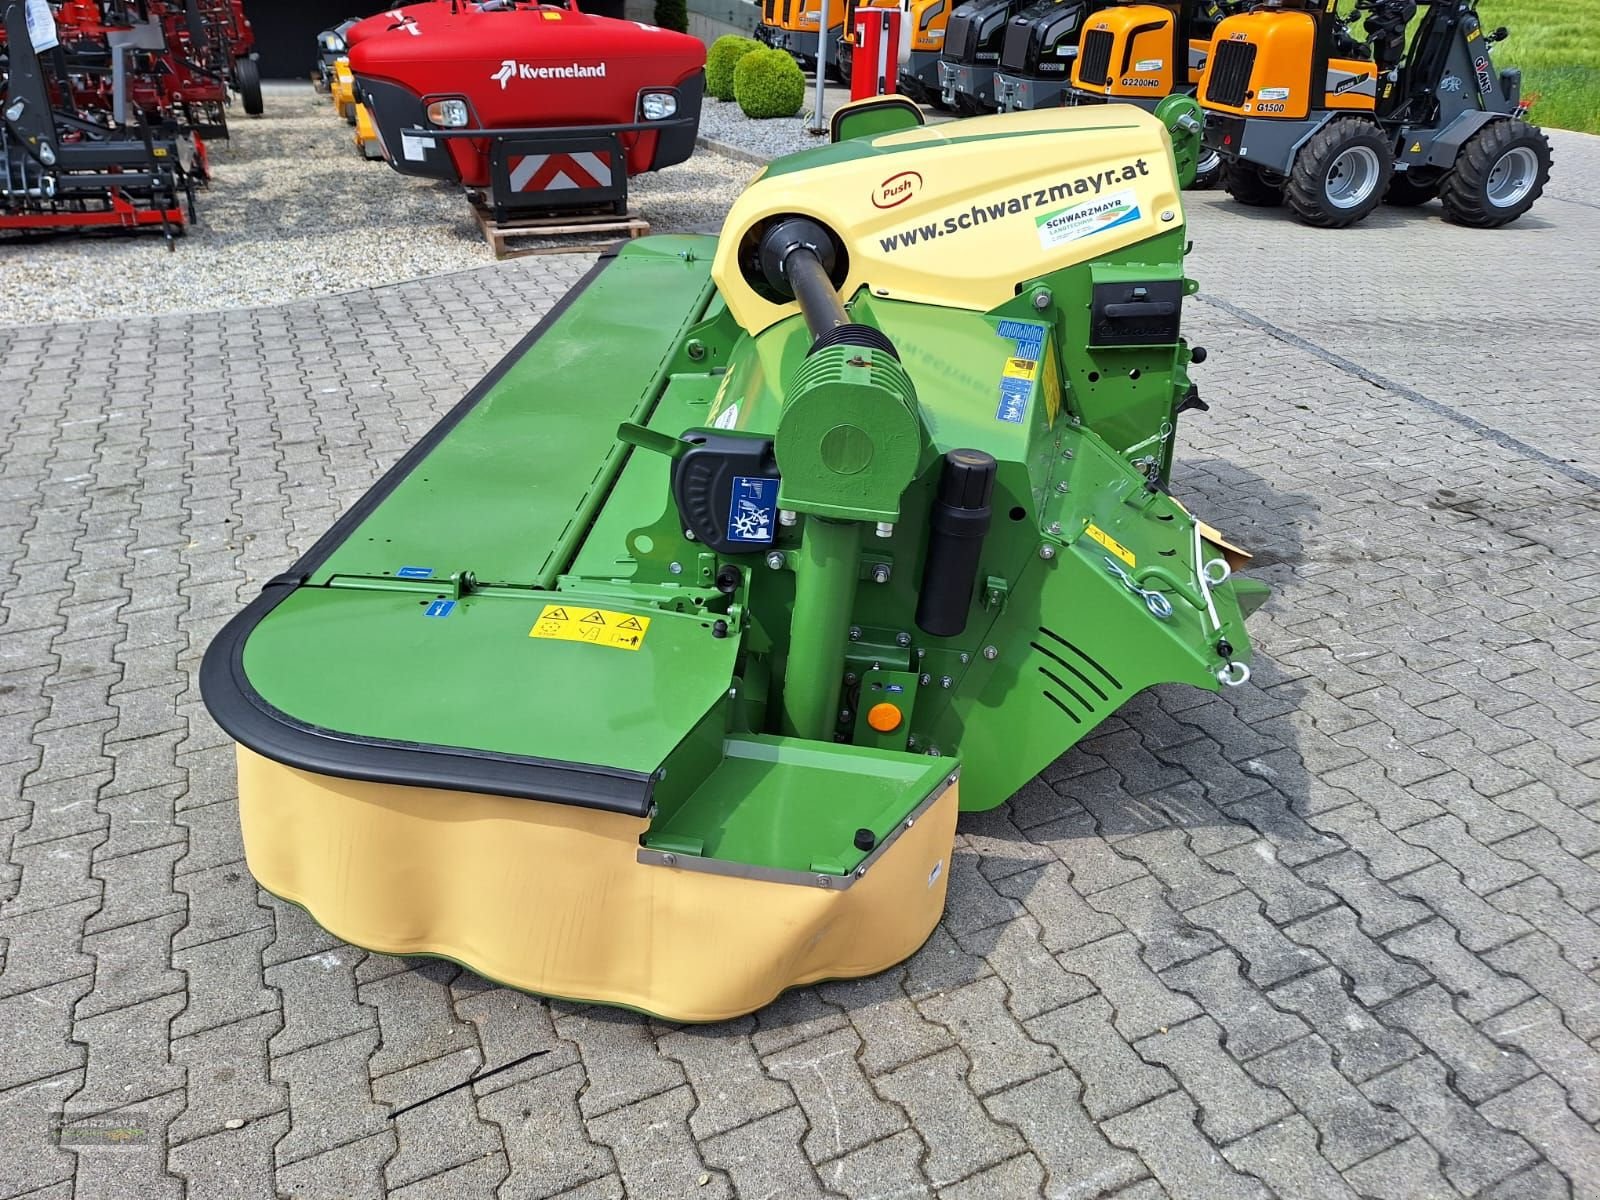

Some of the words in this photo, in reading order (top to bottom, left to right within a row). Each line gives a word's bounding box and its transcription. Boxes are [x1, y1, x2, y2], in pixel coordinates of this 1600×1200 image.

[519, 62, 606, 79] Kverneland
[1474, 56, 1493, 95] GIANT
[1122, 78, 1159, 88] G2200HD
[1257, 103, 1285, 112] G1500
[883, 179, 912, 200] Push
[879, 158, 1150, 254] www.schwarzmayr.at
[1046, 199, 1122, 229] SCHWARZMAYR
